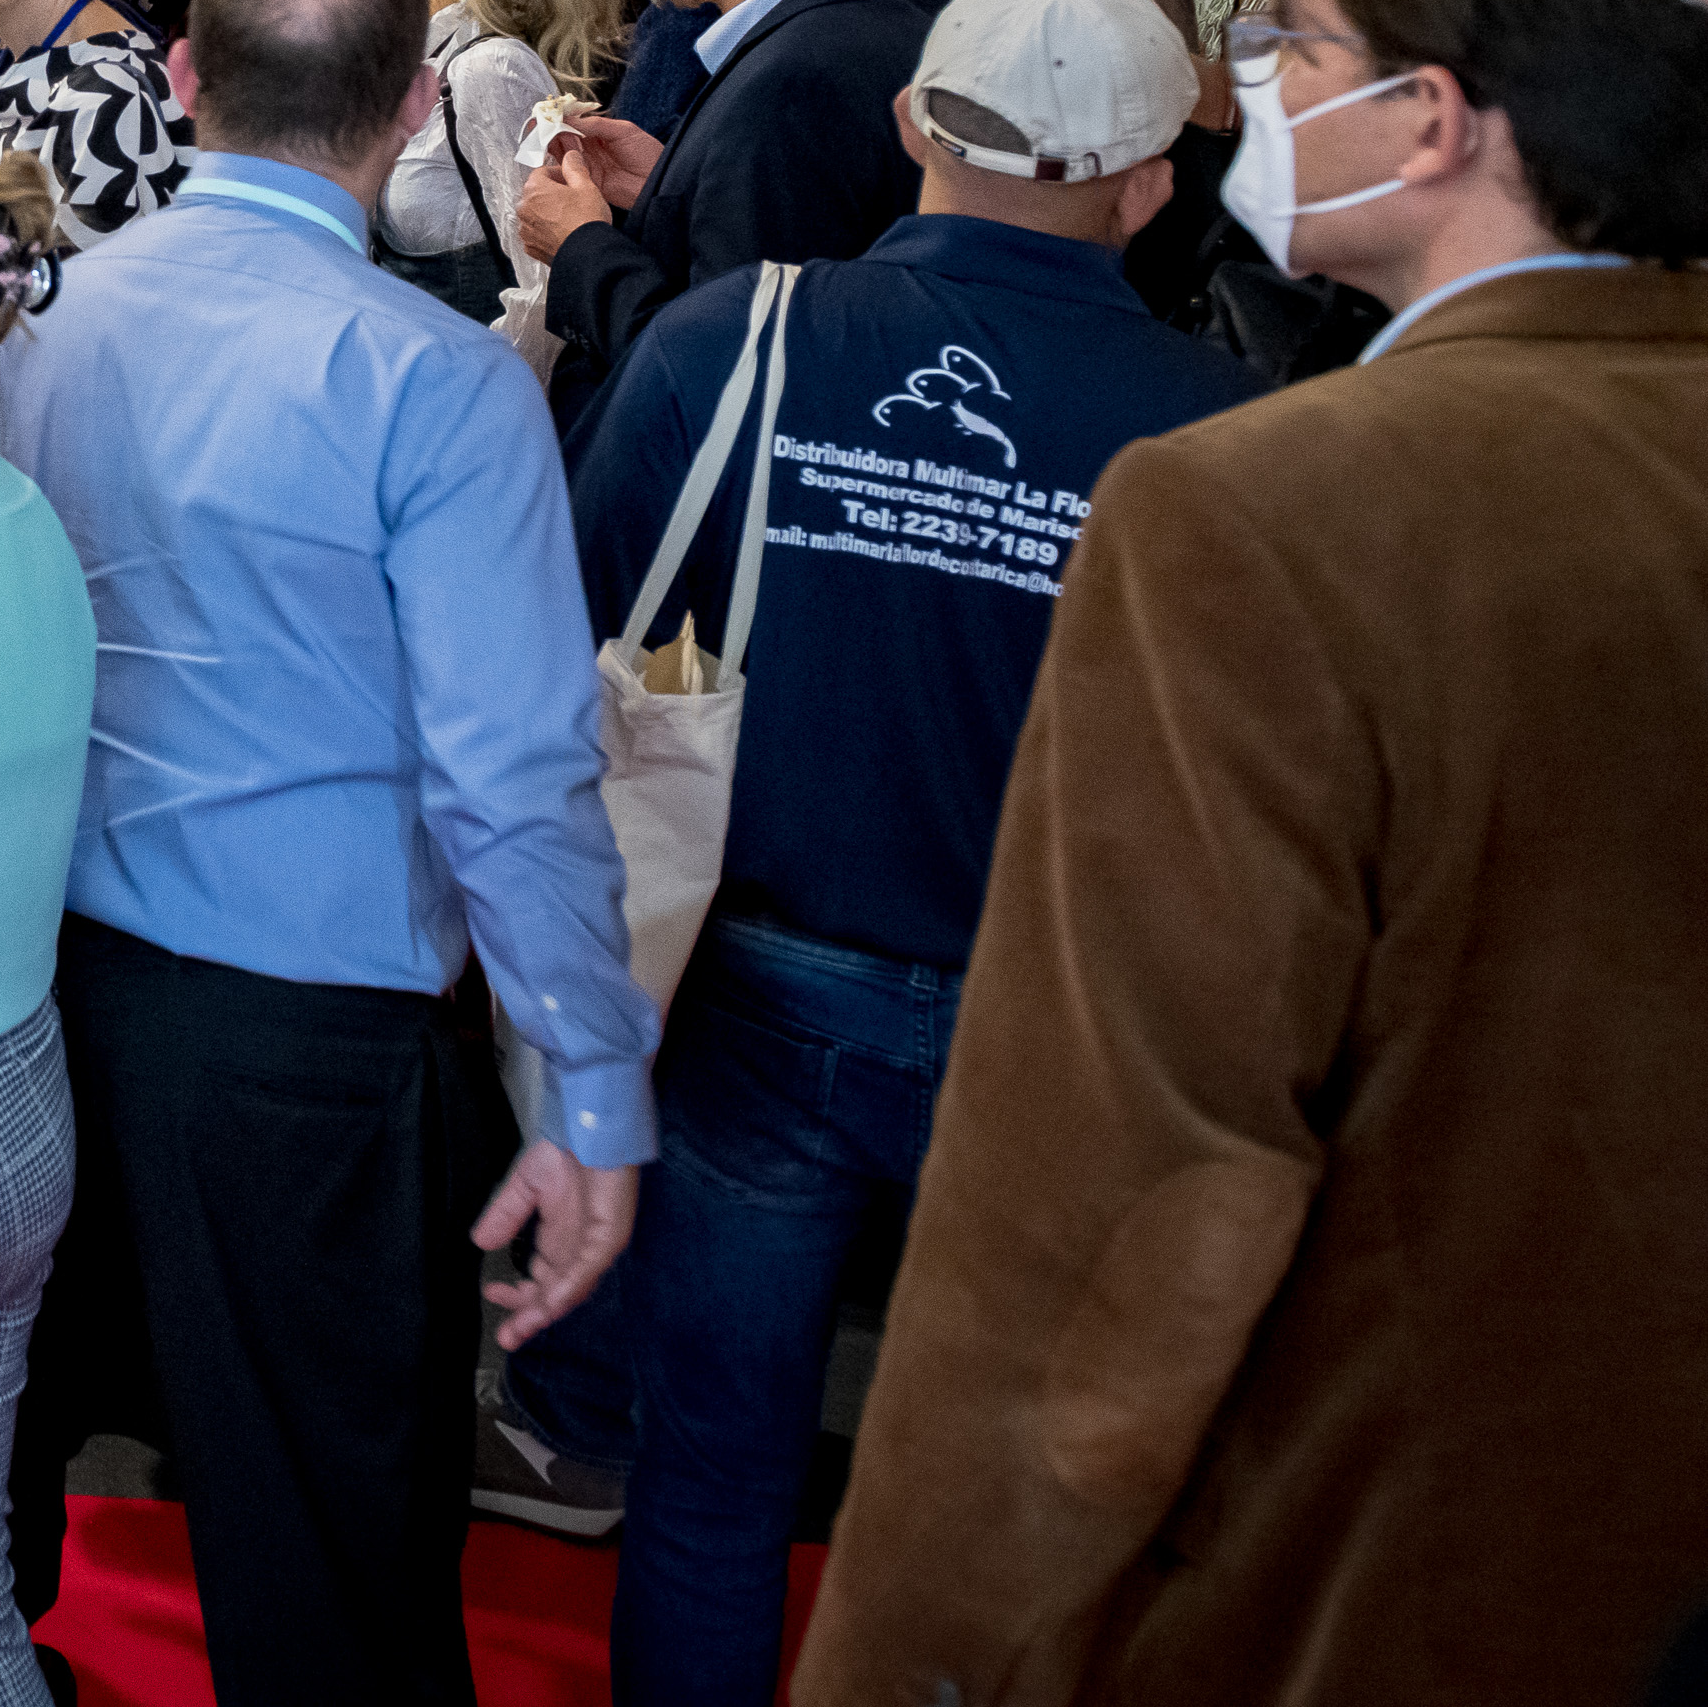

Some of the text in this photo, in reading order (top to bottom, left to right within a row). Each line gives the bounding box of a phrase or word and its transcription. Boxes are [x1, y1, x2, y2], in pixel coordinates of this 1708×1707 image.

[773, 434, 910, 479] Distribuidora
[914, 458, 1012, 499] Multimar
[1014, 481, 1048, 510] La
[799, 467, 964, 513] Supermercado
[966, 497, 995, 519] de
[841, 499, 1060, 566] Tel: 2239-7189
